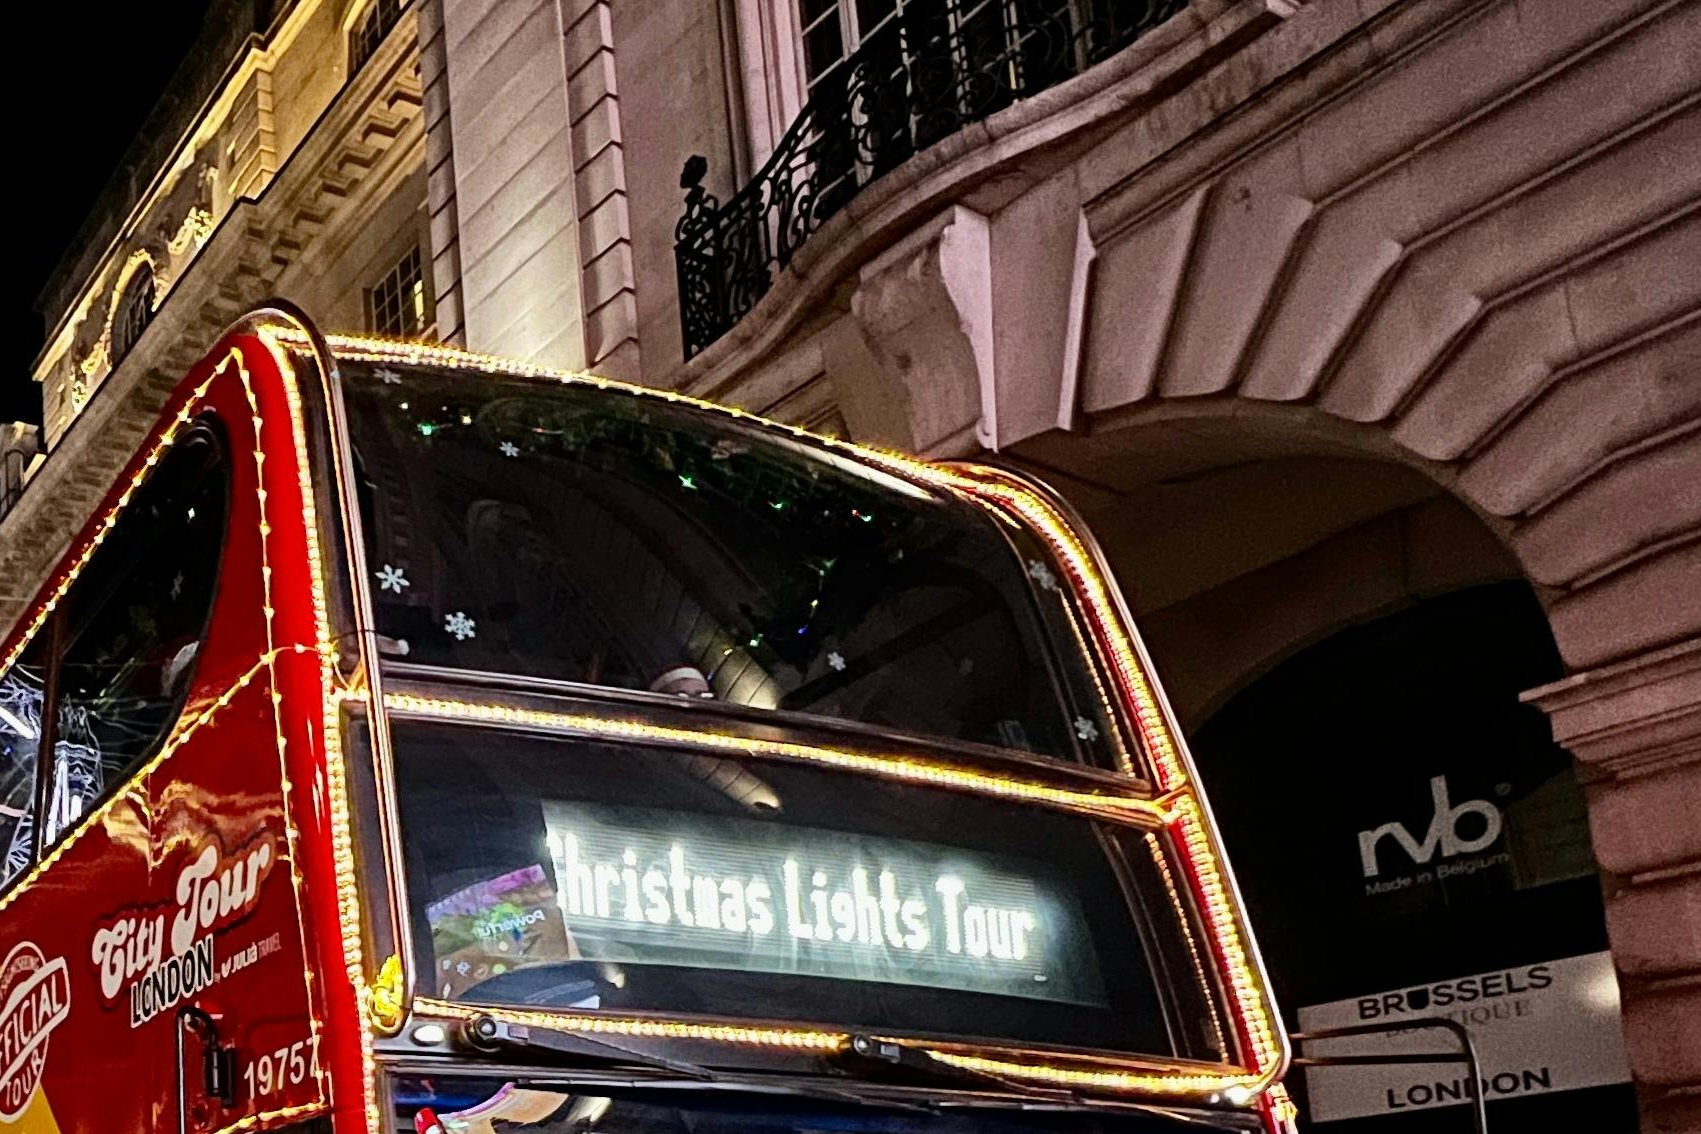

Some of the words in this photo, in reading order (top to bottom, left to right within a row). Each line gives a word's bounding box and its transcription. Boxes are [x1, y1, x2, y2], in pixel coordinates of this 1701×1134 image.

[1358, 774, 1502, 877] rvb
[92, 914, 165, 999] City
[171, 843, 271, 957] Tour
[783, 857, 931, 951] Lights
[935, 873, 1037, 960] Tour
[1365, 876, 1413, 896] Made
[1417, 871, 1433, 884] in
[1436, 853, 1509, 879] Belgium
[131, 933, 213, 1028] LONDON
[1358, 966, 1553, 1020] BRUSSELS
[6, 1048, 43, 1107] TOUR
